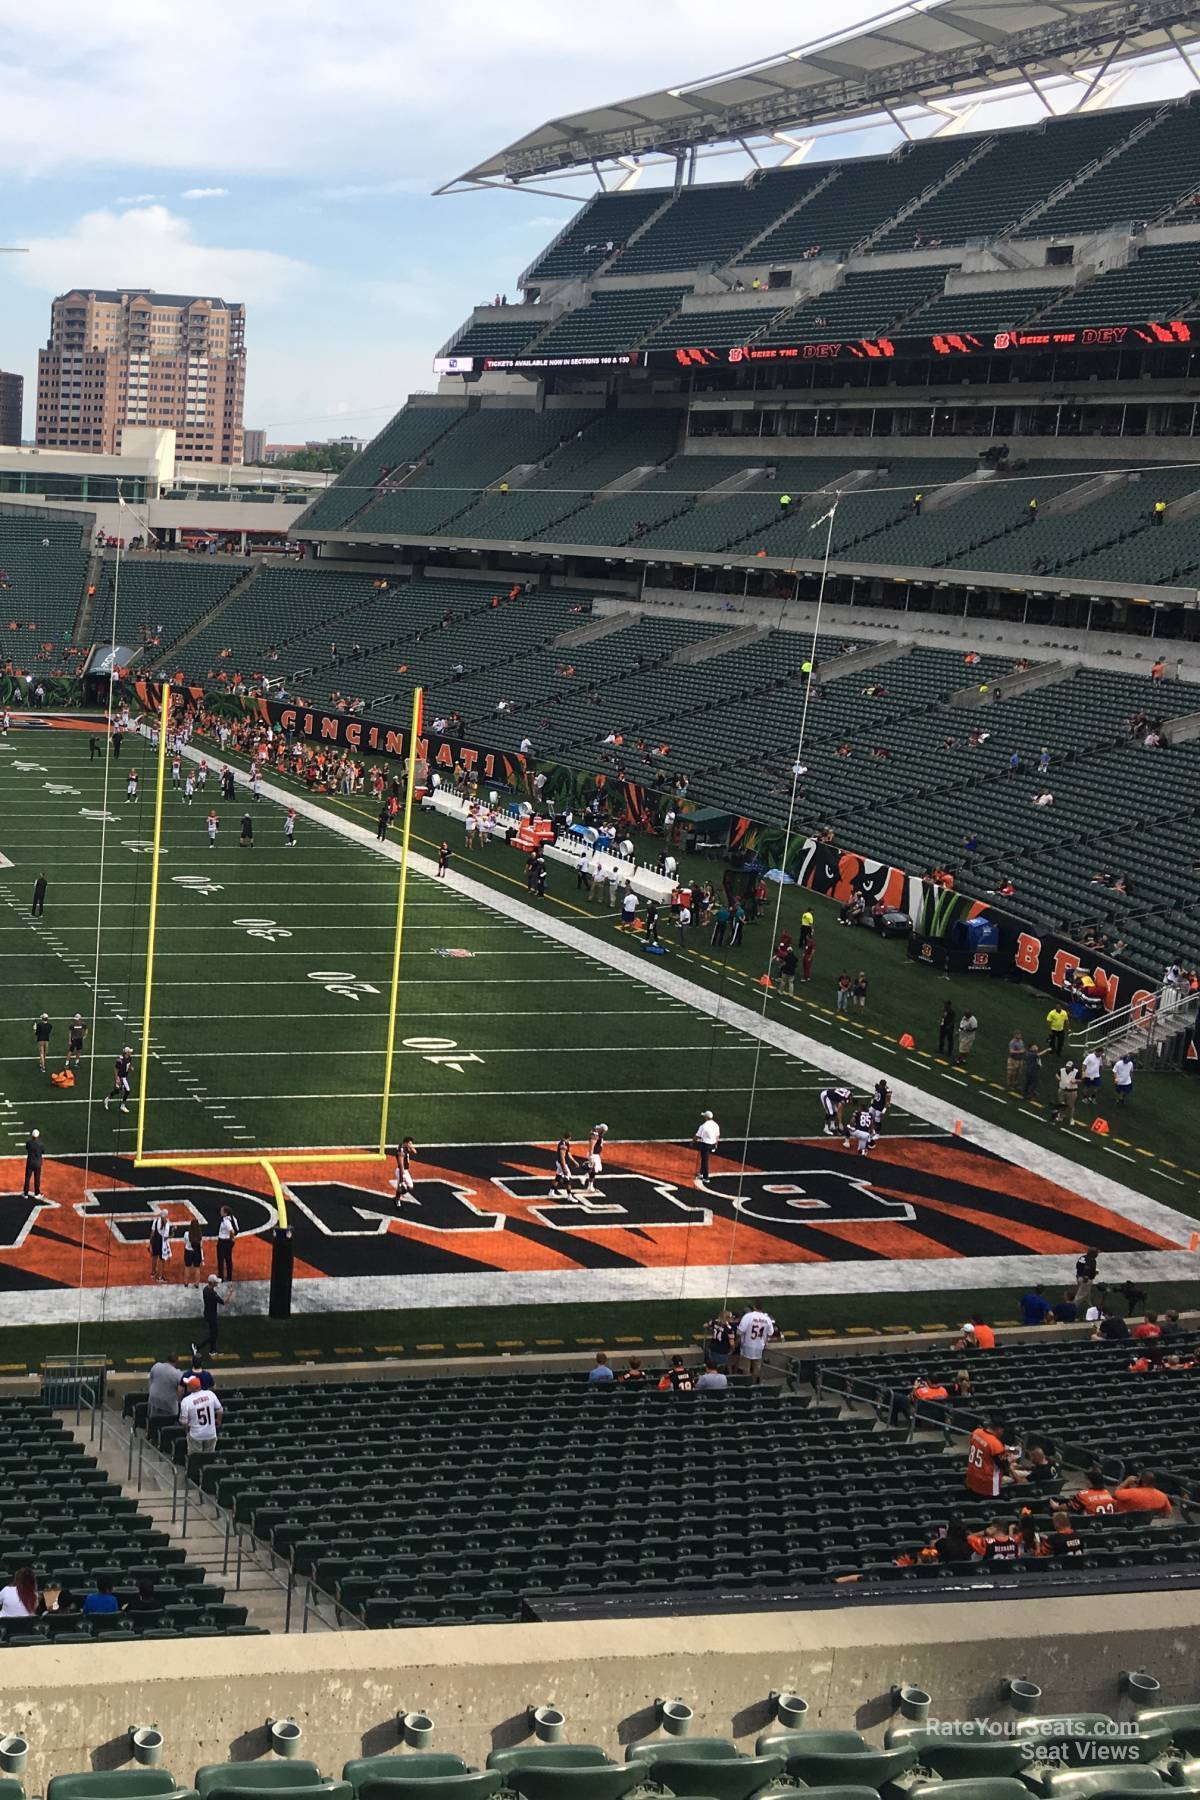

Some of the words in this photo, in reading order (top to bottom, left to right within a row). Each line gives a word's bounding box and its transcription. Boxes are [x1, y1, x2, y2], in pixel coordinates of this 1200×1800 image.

[1019, 335, 1050, 344] SEIZE
[1053, 334, 1076, 343] THE
[1081, 327, 1128, 345] DEY
[751, 350, 777, 358] SEIZE
[780, 349, 798, 357] THE
[803, 344, 841, 358] DEY
[281, 709, 494, 778] CINCINNATI
[307, 971, 381, 994] 20
[402, 1037, 485, 1064] 10
[860, 1114, 872, 1128] 85
[196, 1406, 211, 1425] 51
[969, 1445, 983, 1468] 85
[1066, 1539, 1080, 1547] GREEN
